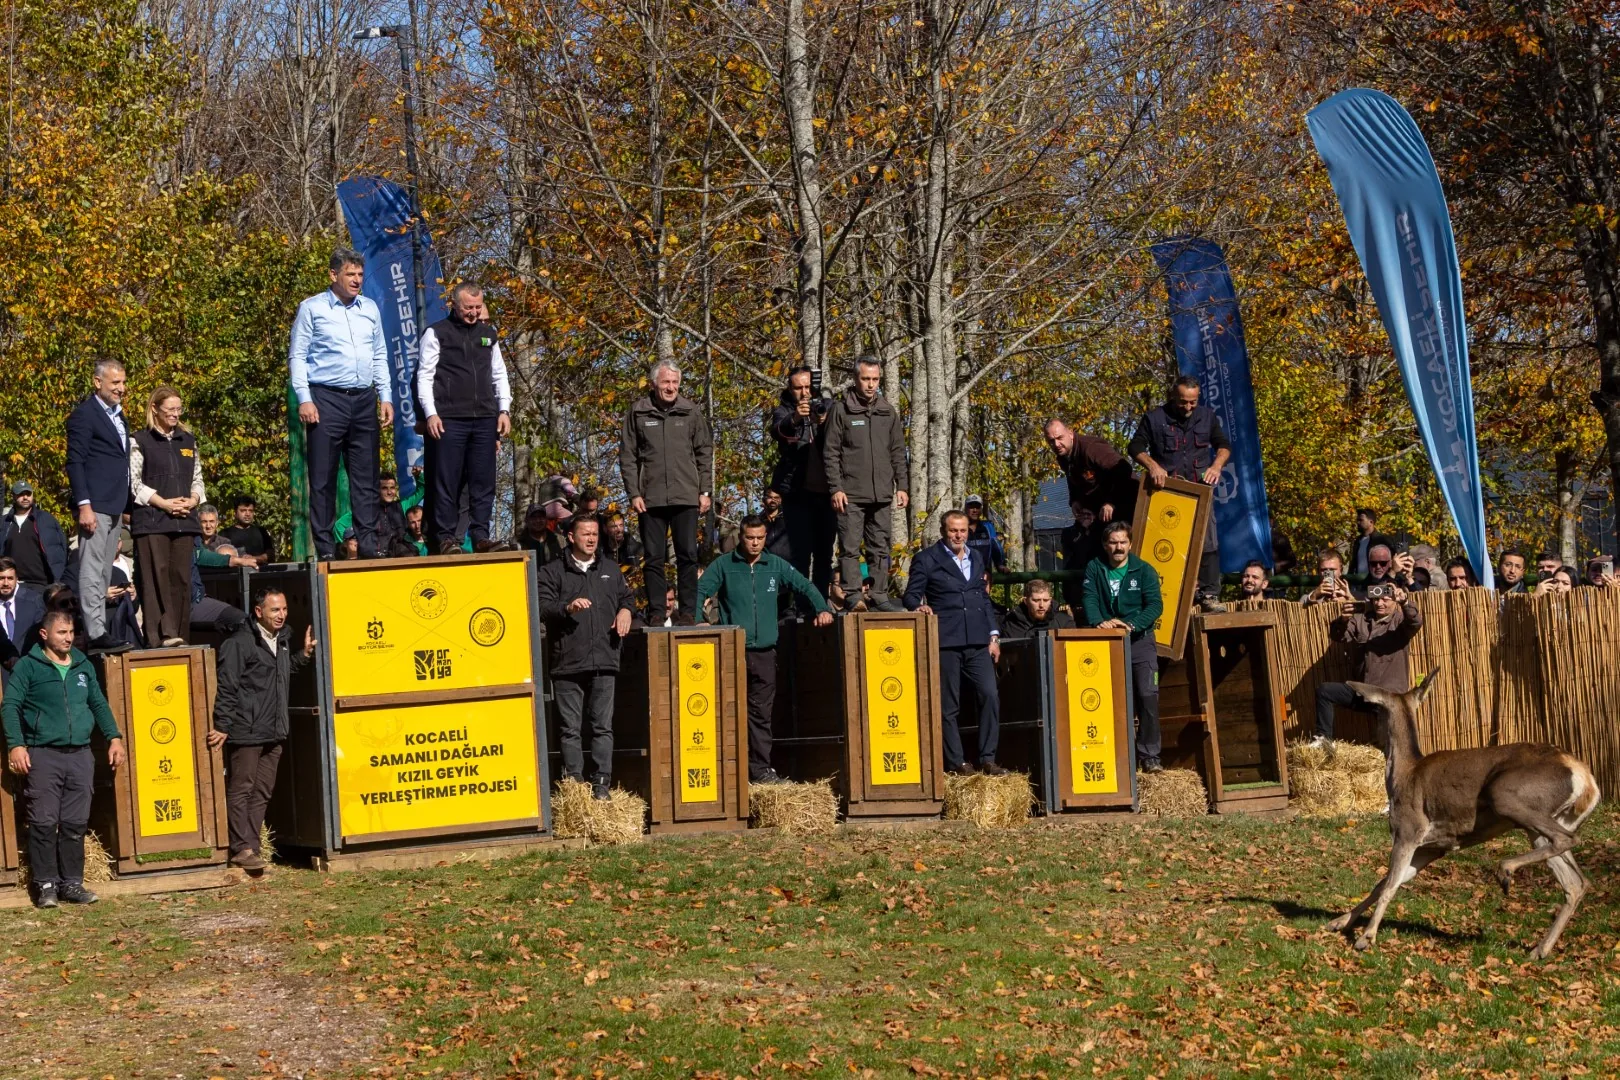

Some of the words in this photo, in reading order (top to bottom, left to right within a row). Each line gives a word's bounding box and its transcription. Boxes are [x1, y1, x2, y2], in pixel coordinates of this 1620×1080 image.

[391, 336, 416, 427] KOCAELİ
[438, 666, 452, 679] ya
[405, 726, 467, 746] KOCAELİ
[370, 750, 437, 767] SAMANLI
[440, 743, 503, 761] DAĞLARI
[398, 769, 433, 783] KIZIL
[436, 762, 479, 779] GEYİK
[360, 785, 456, 805] YERLEŞTİRME
[459, 776, 517, 796] PROJESİ
